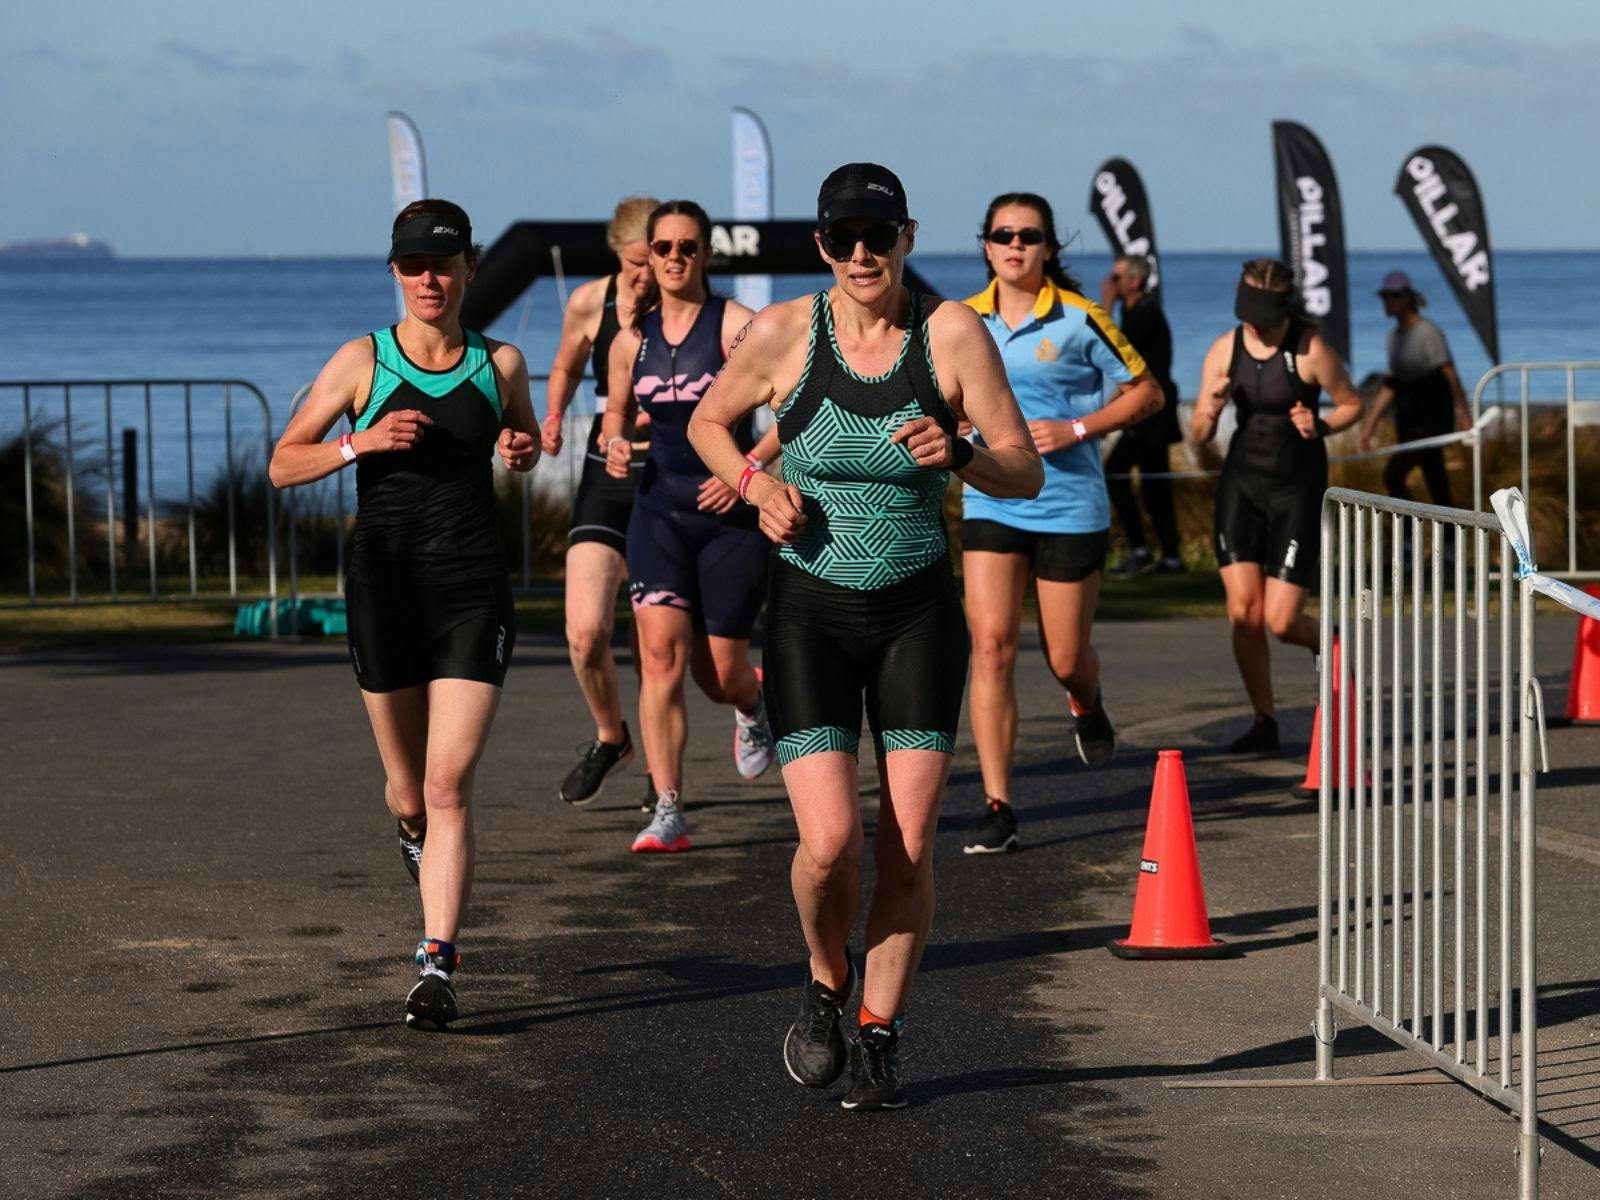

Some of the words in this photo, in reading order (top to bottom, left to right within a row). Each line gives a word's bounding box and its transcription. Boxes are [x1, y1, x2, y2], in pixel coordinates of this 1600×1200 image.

[432, 226, 459, 236] 2XU
[1296, 176, 1331, 316] PILLAR
[1406, 155, 1490, 292] PILLAR
